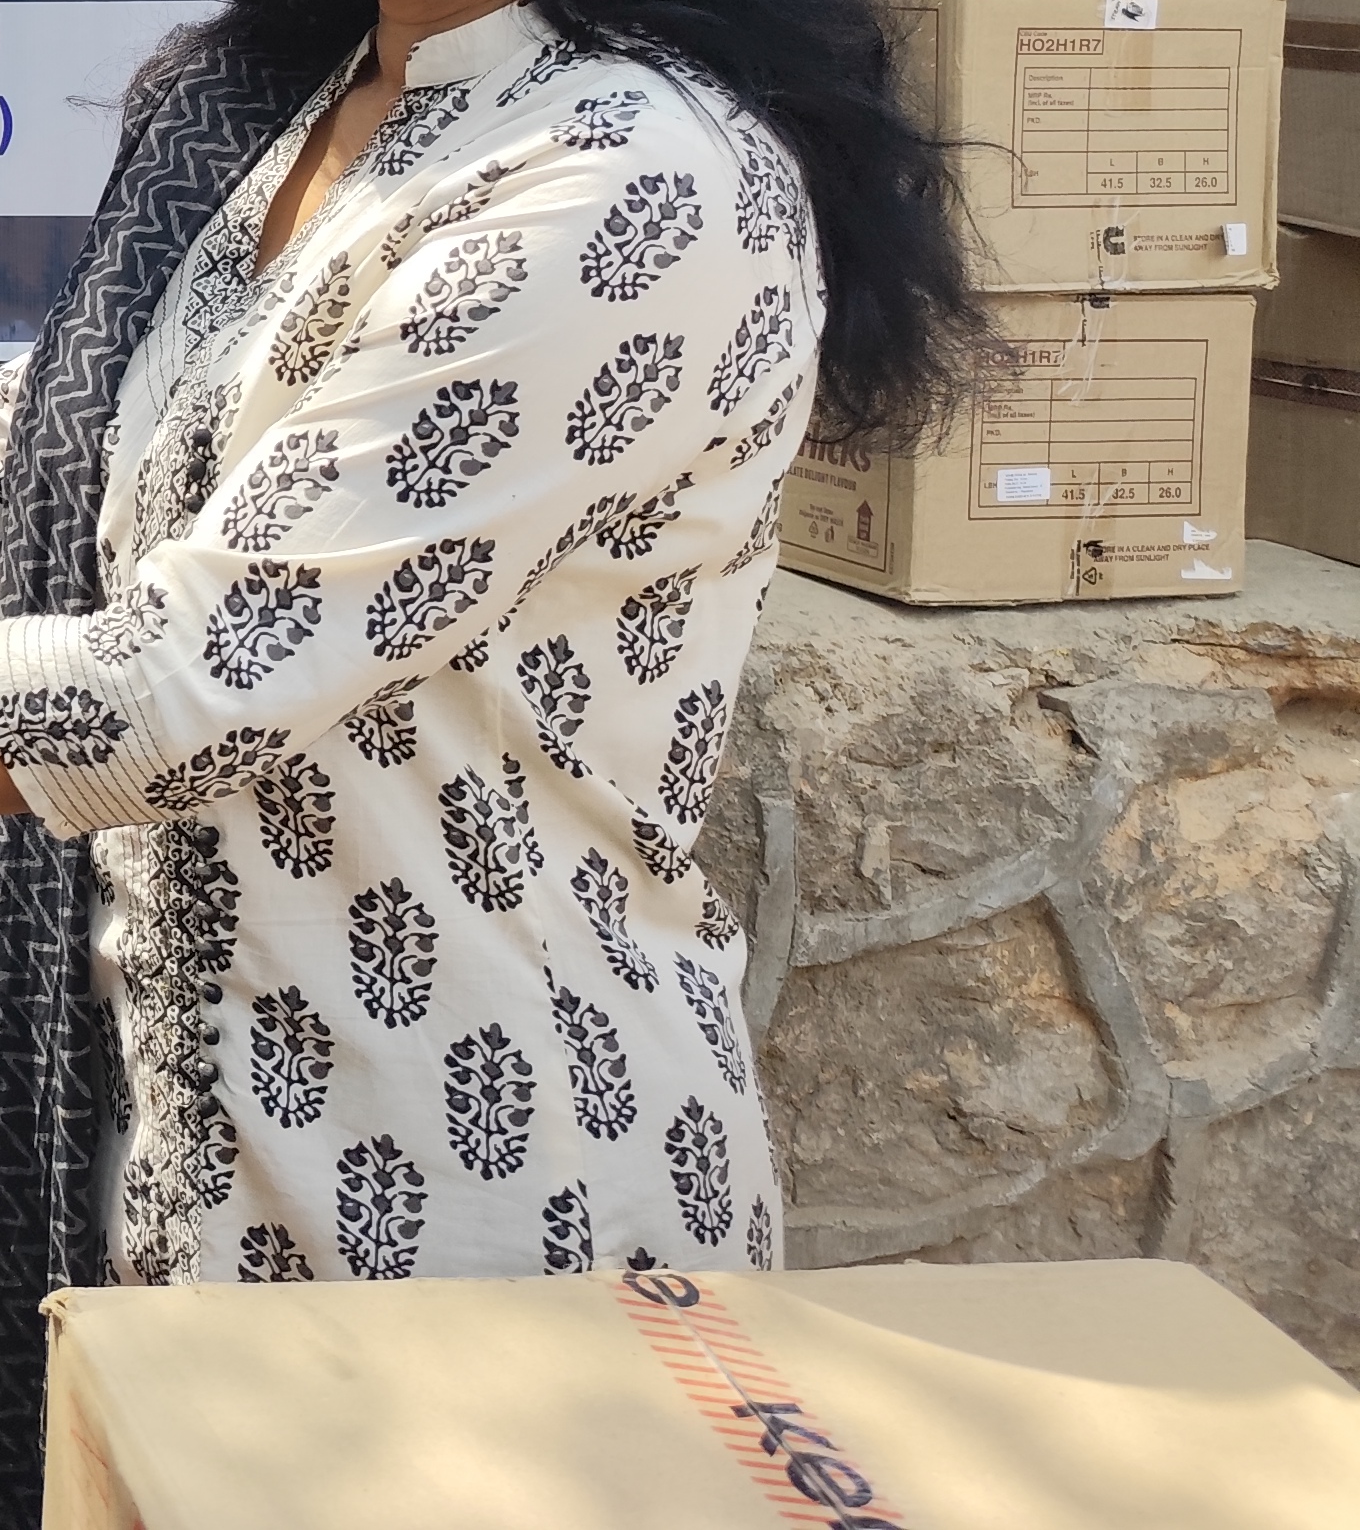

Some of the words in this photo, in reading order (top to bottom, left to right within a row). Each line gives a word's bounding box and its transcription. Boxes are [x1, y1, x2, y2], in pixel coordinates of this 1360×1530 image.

[1019, 38, 1102, 52] HO2H1R7
[1110, 158, 1115, 167] L
[1158, 158, 1163, 166] B
[1203, 157, 1209, 165] H
[1100, 178, 1123, 189] 41.5
[1149, 177, 1172, 188] 32.5
[1195, 177, 1217, 188] 26.0
[1062, 489, 1085, 501] 41.5
[1158, 488, 1181, 499] 26.0
[1132, 545, 1154, 553] CLEAN
